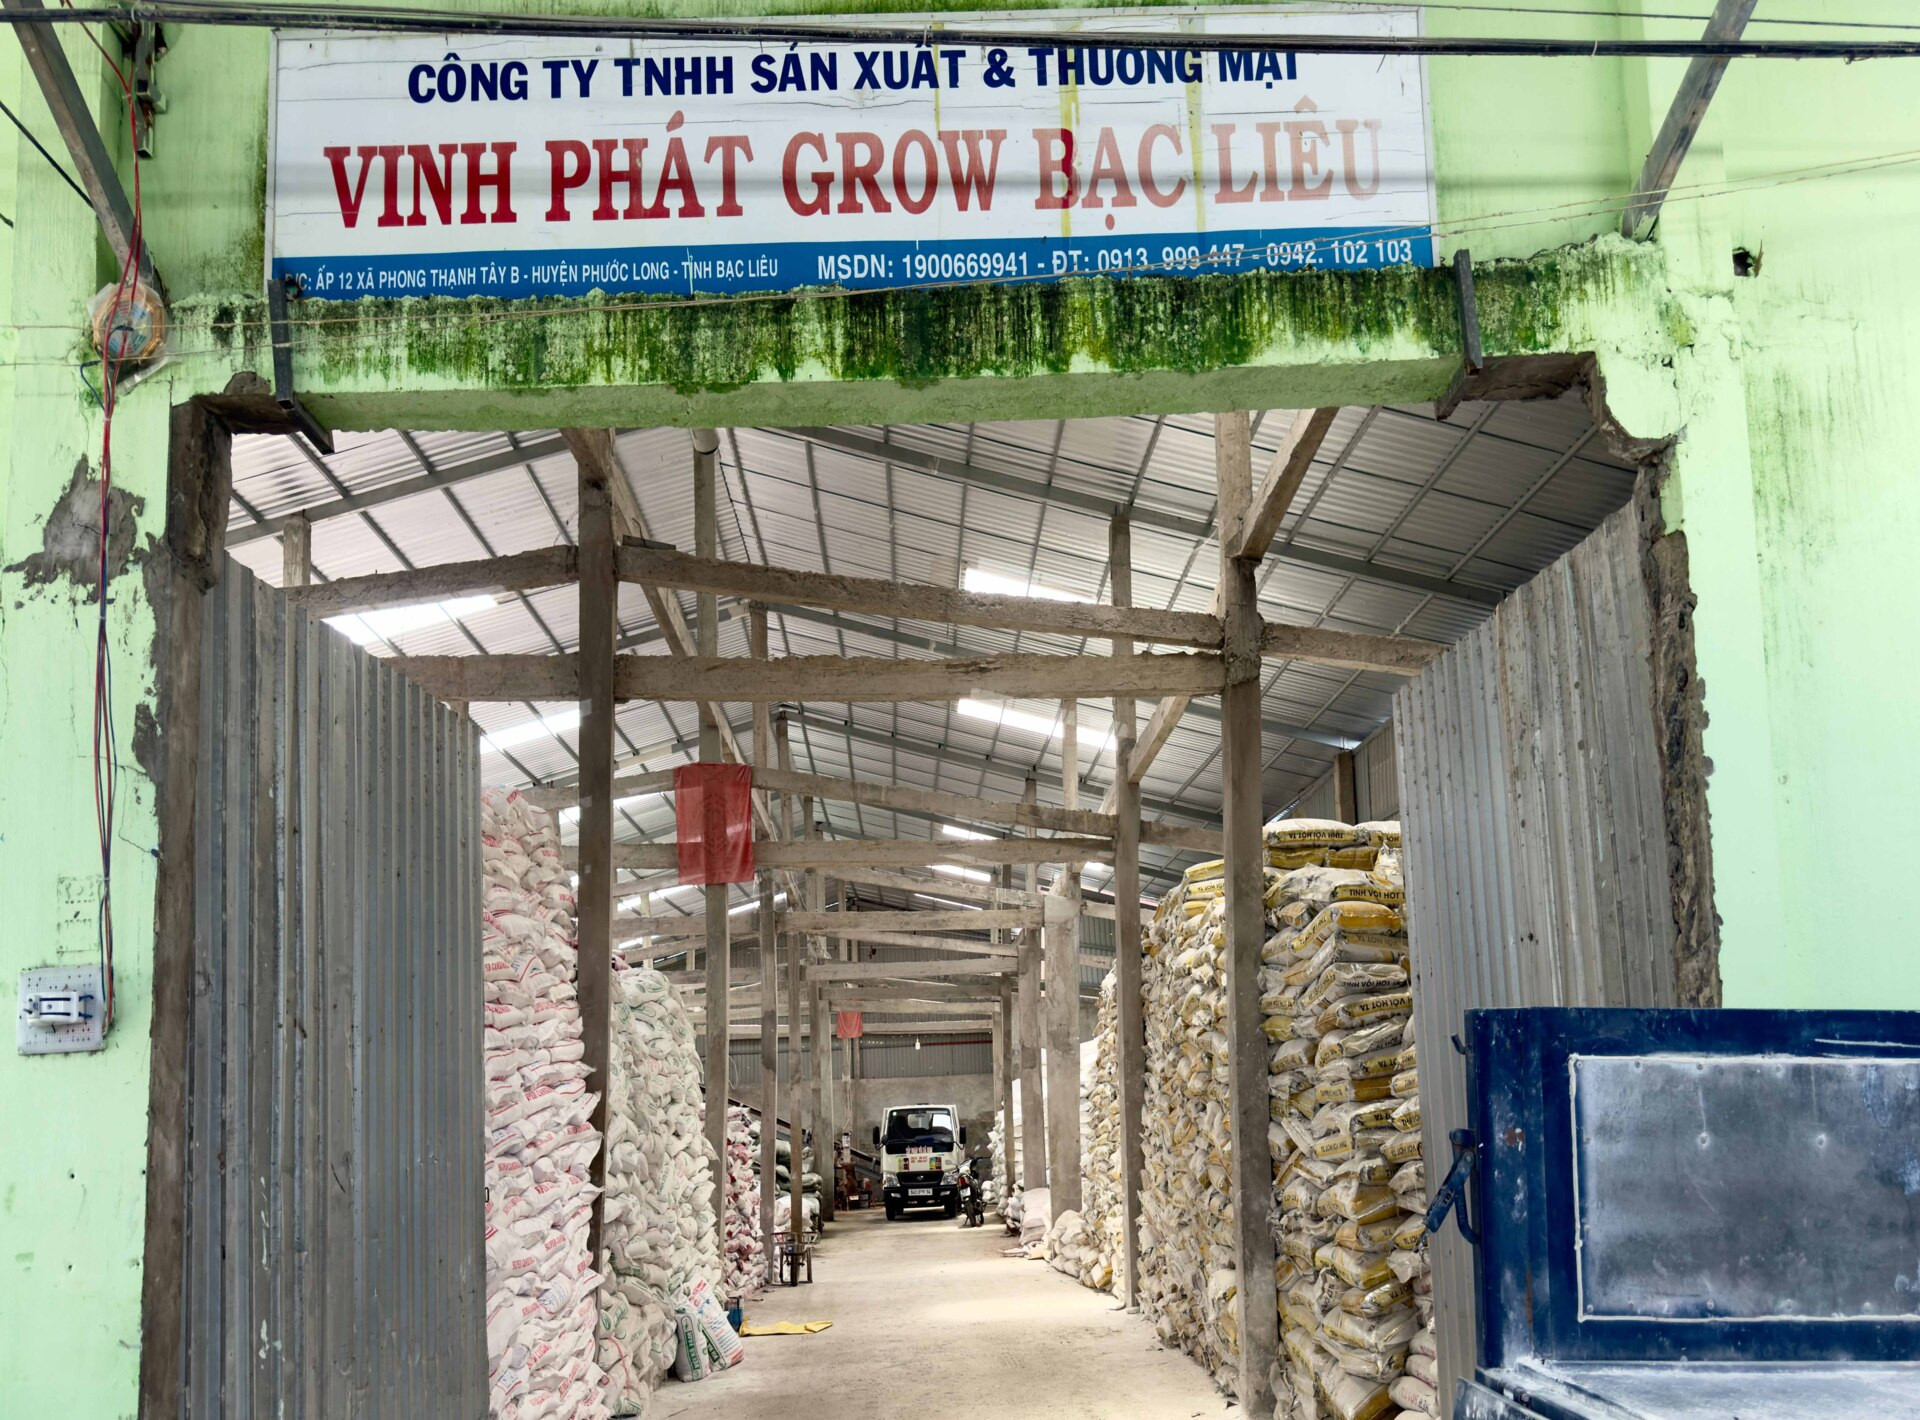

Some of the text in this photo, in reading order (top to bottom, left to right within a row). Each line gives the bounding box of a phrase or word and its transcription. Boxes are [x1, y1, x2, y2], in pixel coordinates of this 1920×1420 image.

[408, 53, 528, 103] CÔNG
[542, 59, 599, 99] TY
[614, 56, 733, 97] TNHH
[983, 48, 1016, 88] &
[323, 94, 1382, 231] VINH PHÁT GROW BẠC LIÊU
[315, 264, 335, 291] ẤP
[338, 272, 353, 290] 12
[357, 267, 375, 290] XÃ
[379, 269, 426, 289] PHONG
[430, 266, 476, 290] THẠNH
[480, 261, 507, 284] TÂY
[511, 266, 520, 284] B
[532, 260, 578, 286] HUYỆN
[582, 259, 629, 283] PHƯỚC
[633, 262, 669, 281] LONG
[716, 259, 744, 281] BẠC
[749, 254, 778, 278] LIÊU
[817, 253, 894, 280] MSDN:
[902, 251, 1028, 279] 1900669941
[1052, 250, 1090, 275] ĐT:
[1331, 240, 1368, 264] 102
[1375, 238, 1412, 262] 103
